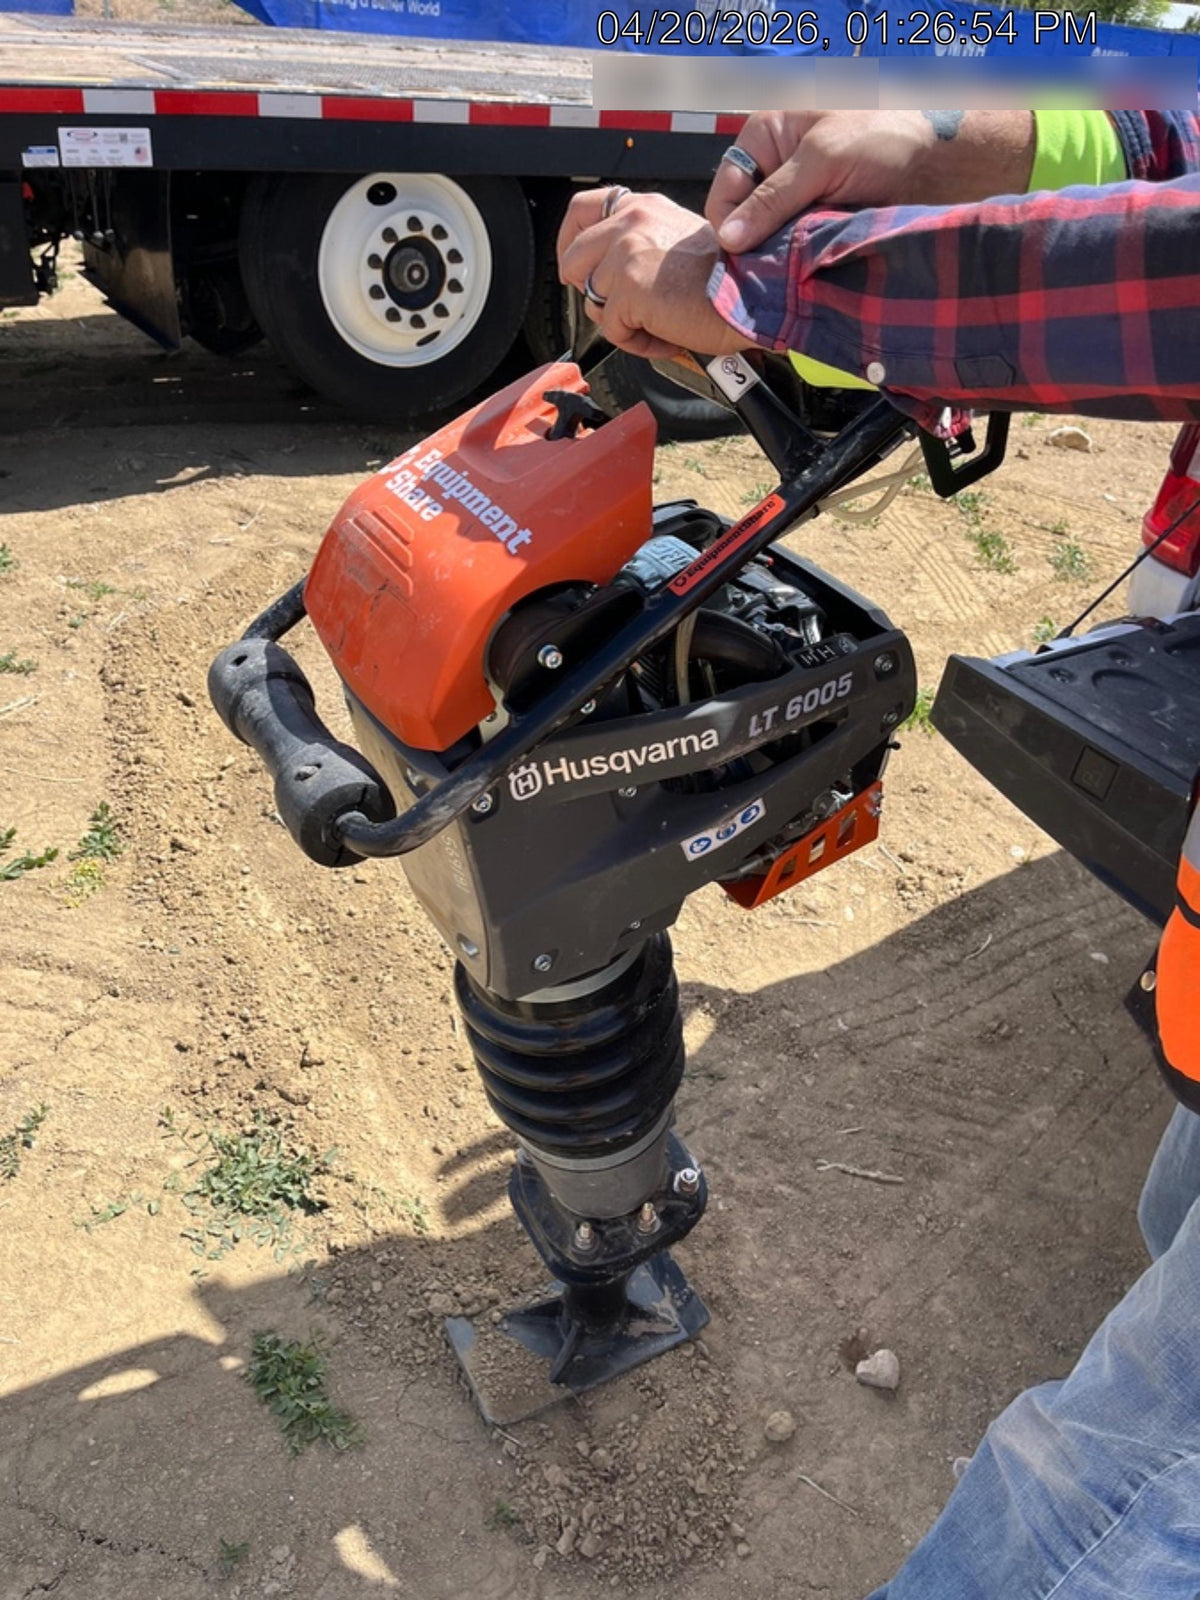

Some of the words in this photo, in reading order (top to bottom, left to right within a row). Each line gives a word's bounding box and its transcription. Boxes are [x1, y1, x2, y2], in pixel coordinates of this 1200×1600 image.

[384, 469, 444, 522] Share
[413, 448, 533, 555] Equipment
[543, 728, 720, 786] Husqvarna
[749, 705, 779, 738] LT
[785, 671, 853, 721] 6005
